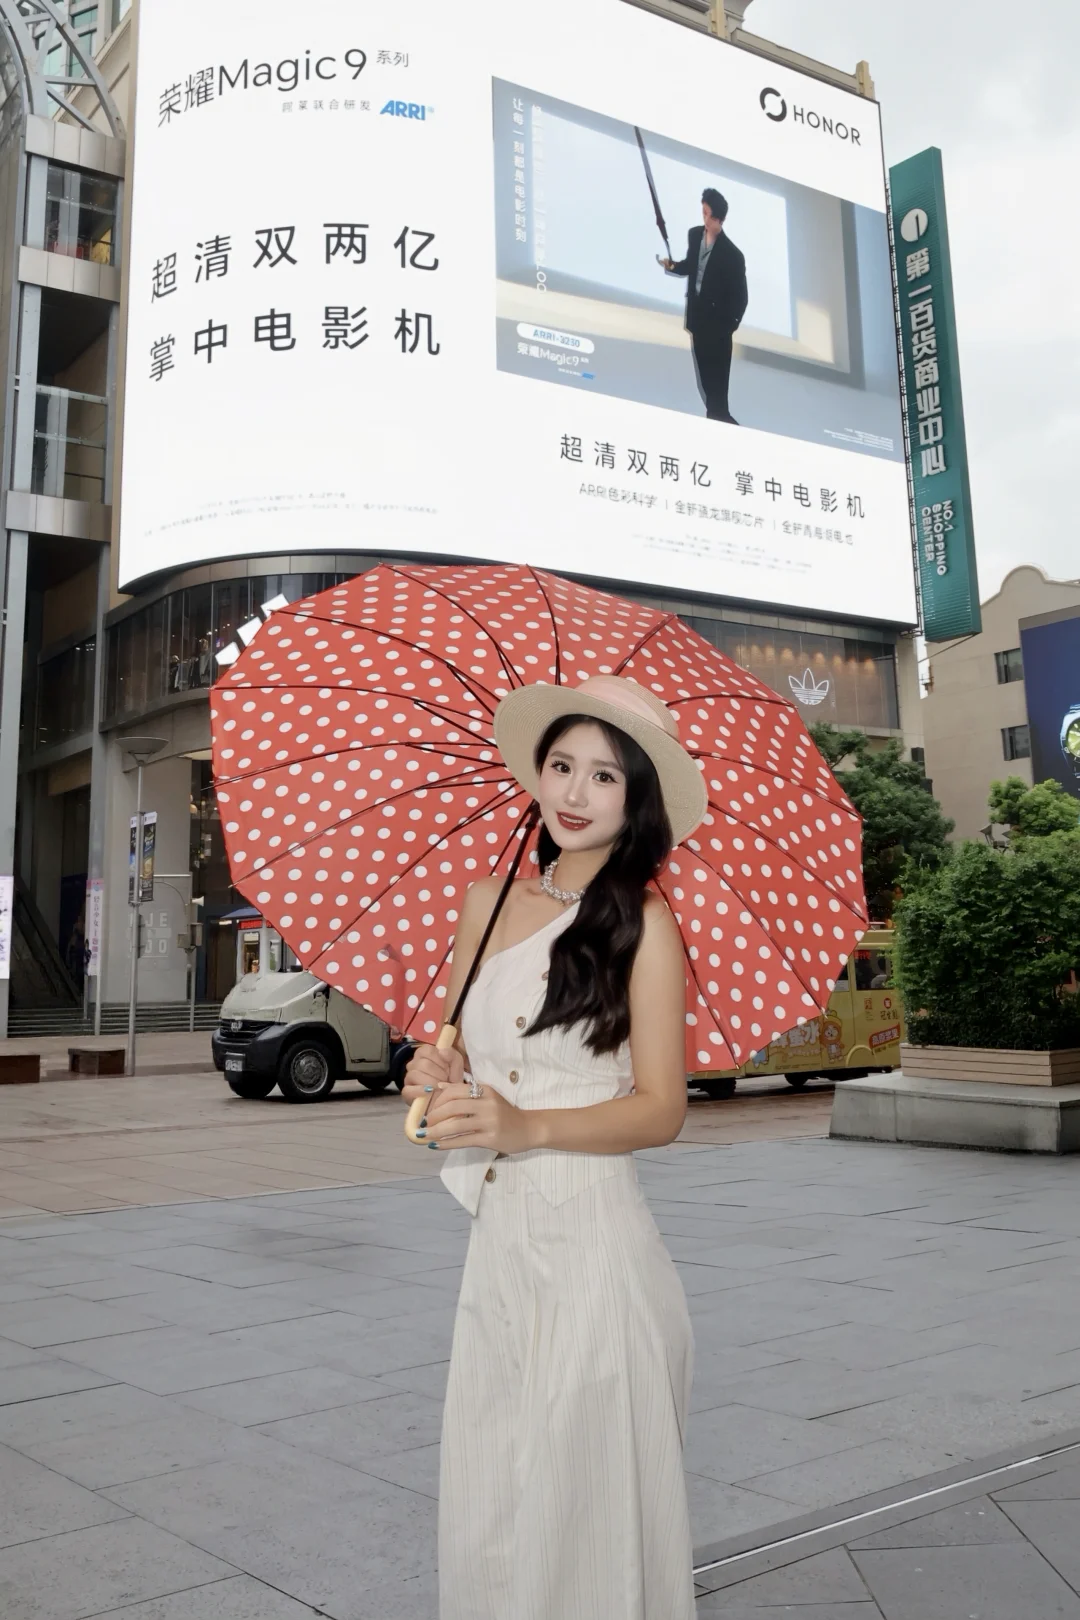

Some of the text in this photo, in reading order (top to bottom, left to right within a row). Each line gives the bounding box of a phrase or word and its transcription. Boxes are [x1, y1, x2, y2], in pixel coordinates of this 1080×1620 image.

[376, 50, 409, 68] 系列
[793, 104, 861, 146] HONOR
[151, 223, 440, 304] 超清双两亿
[149, 306, 441, 382] 掌中电影机
[906, 247, 946, 478] 第一百货商业中心
[560, 434, 865, 519] 超清双两亿 掌中电影机
[922, 506, 936, 562] CENTER
